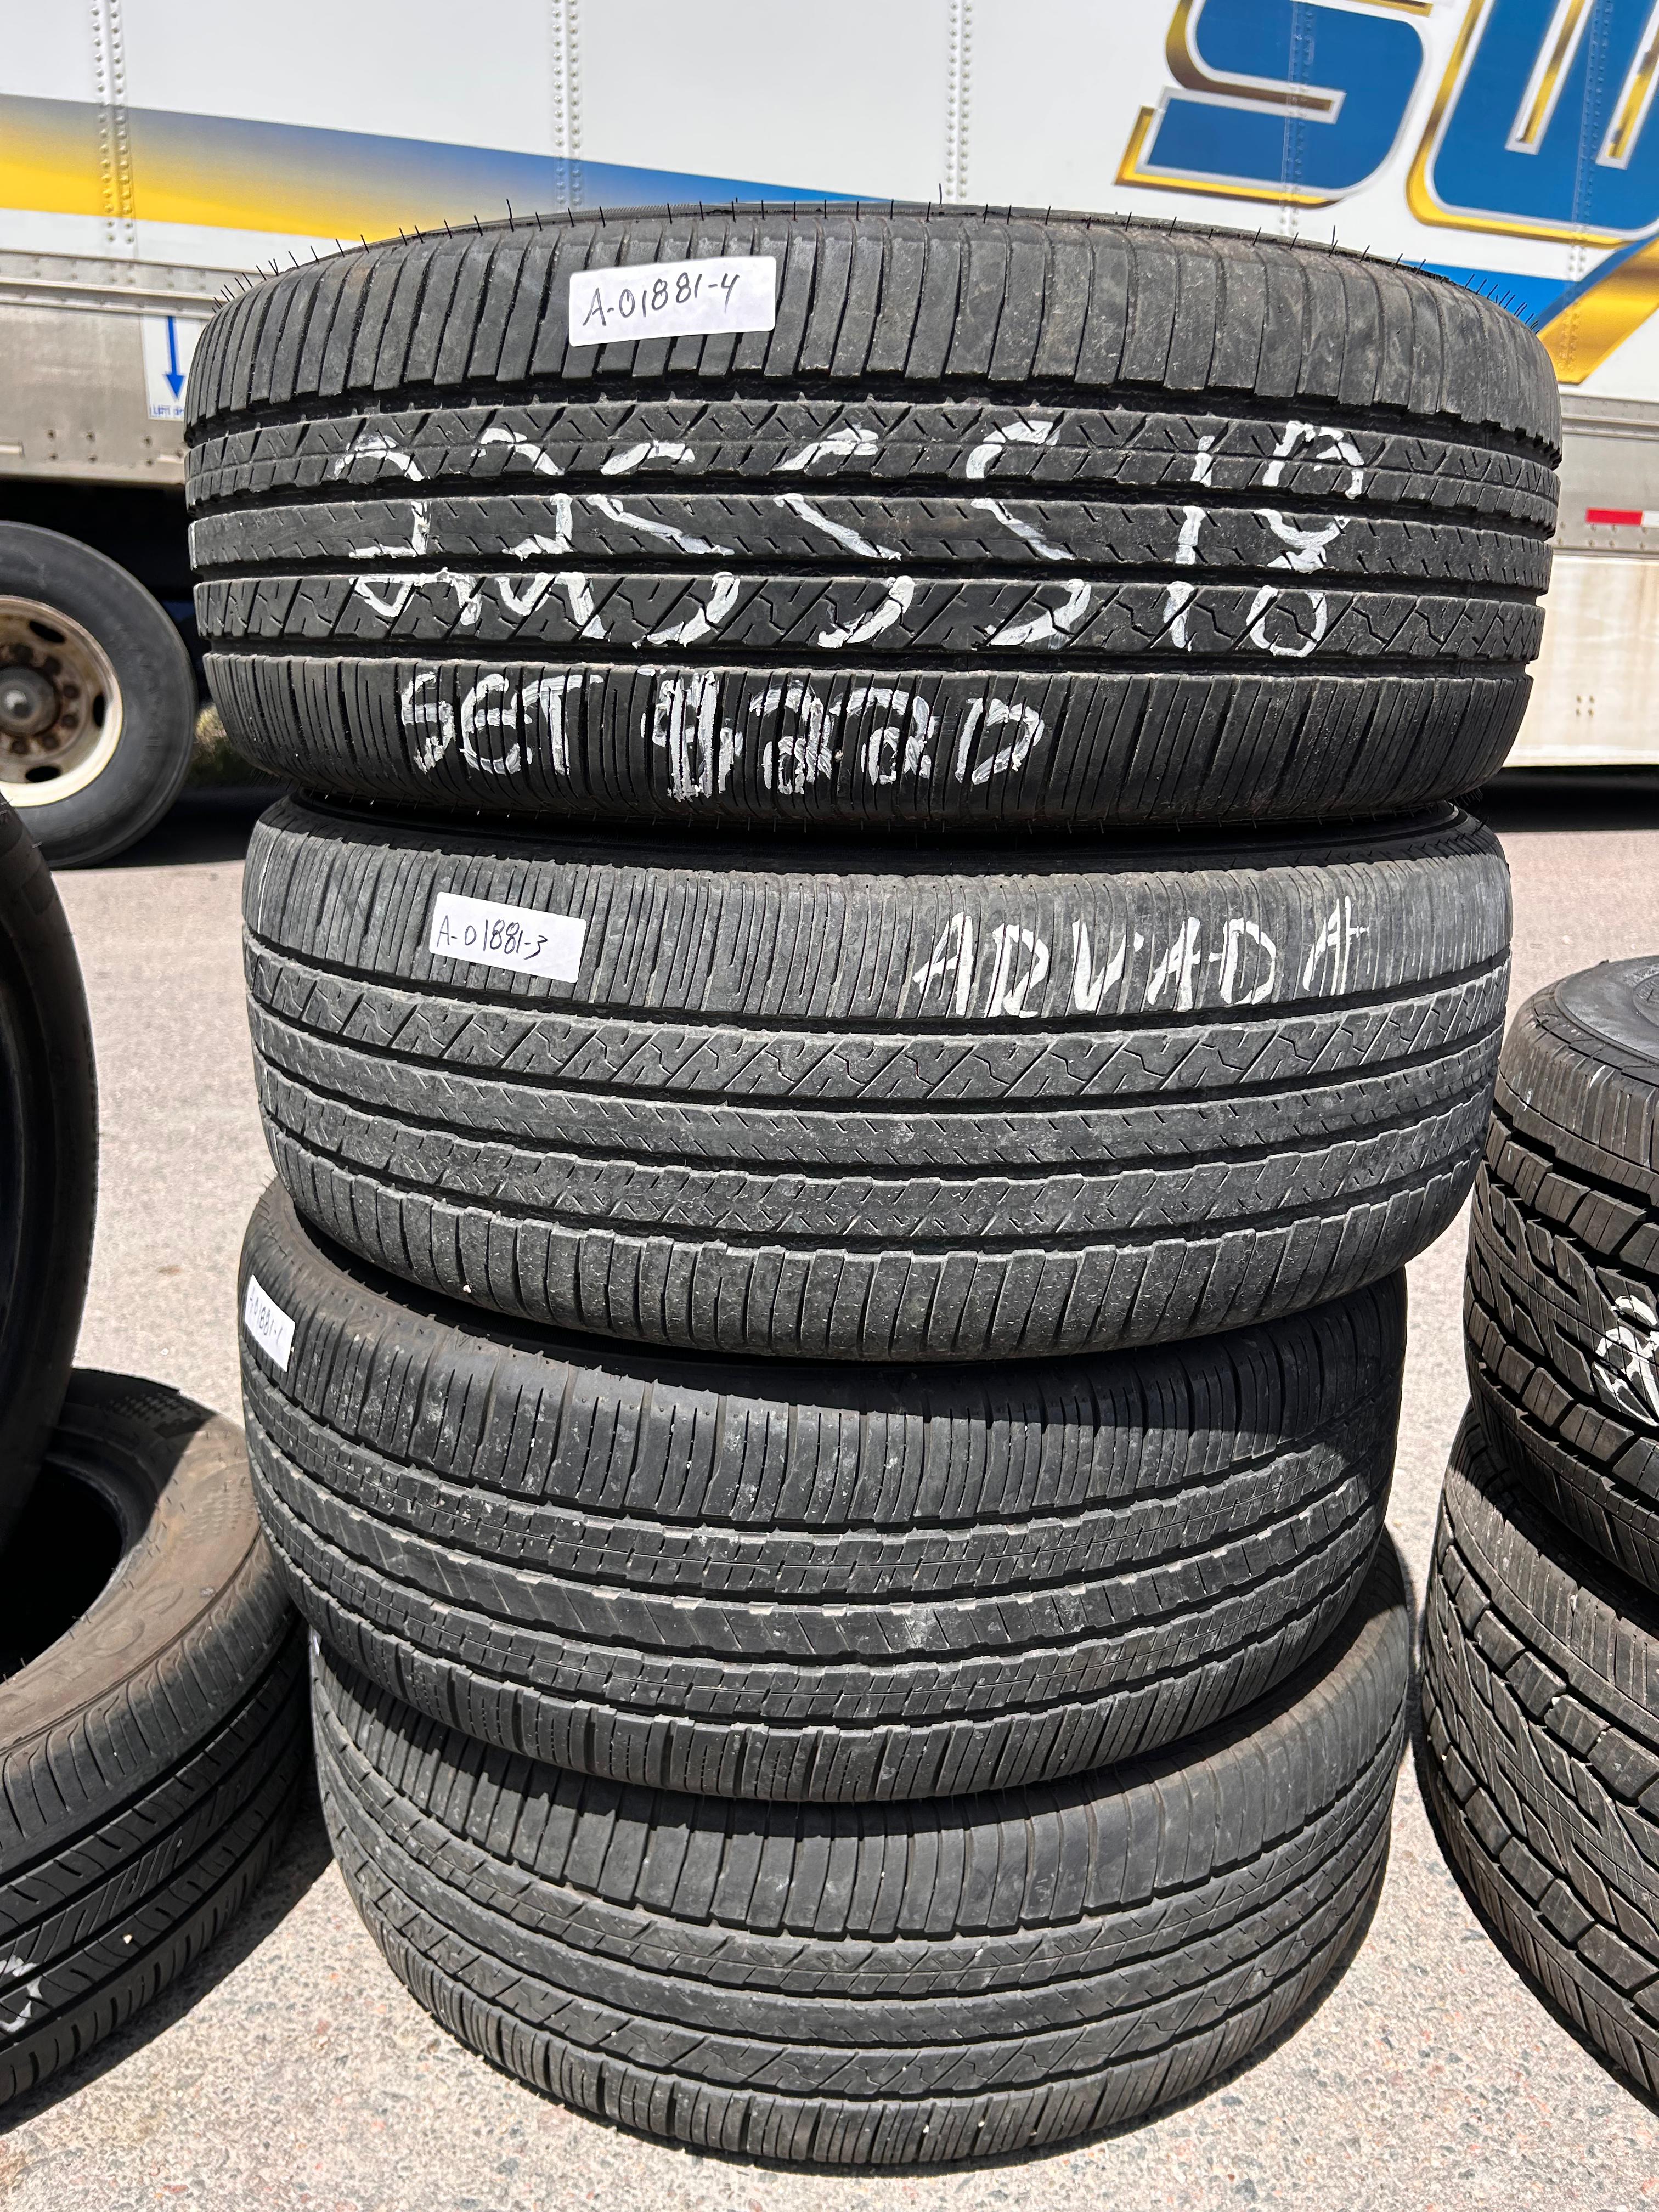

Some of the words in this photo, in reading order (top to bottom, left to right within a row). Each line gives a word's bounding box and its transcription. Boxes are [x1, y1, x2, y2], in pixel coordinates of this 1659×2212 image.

[582, 272, 741, 326] A-01881-4
[400, 670, 604, 776] SET
[436, 915, 549, 960] A-01881-3
